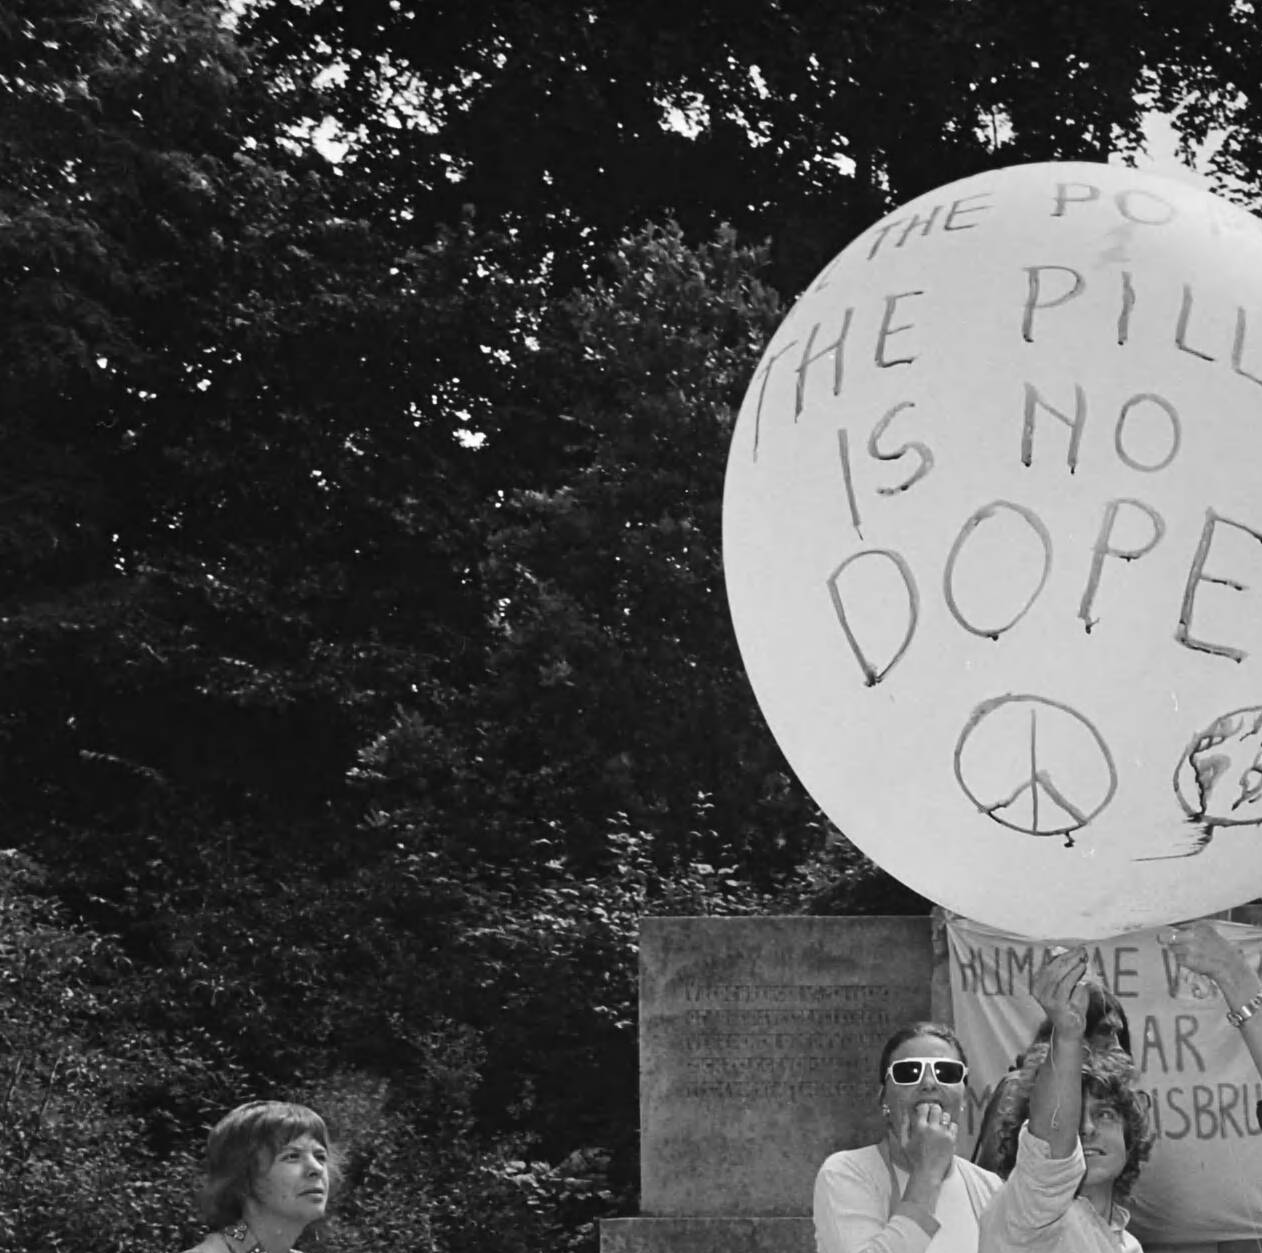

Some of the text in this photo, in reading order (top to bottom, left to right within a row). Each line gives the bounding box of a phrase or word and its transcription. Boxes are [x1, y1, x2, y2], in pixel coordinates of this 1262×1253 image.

[867, 192, 993, 261] THE
[752, 290, 924, 462] THE
[838, 381, 1182, 540] IS NO
